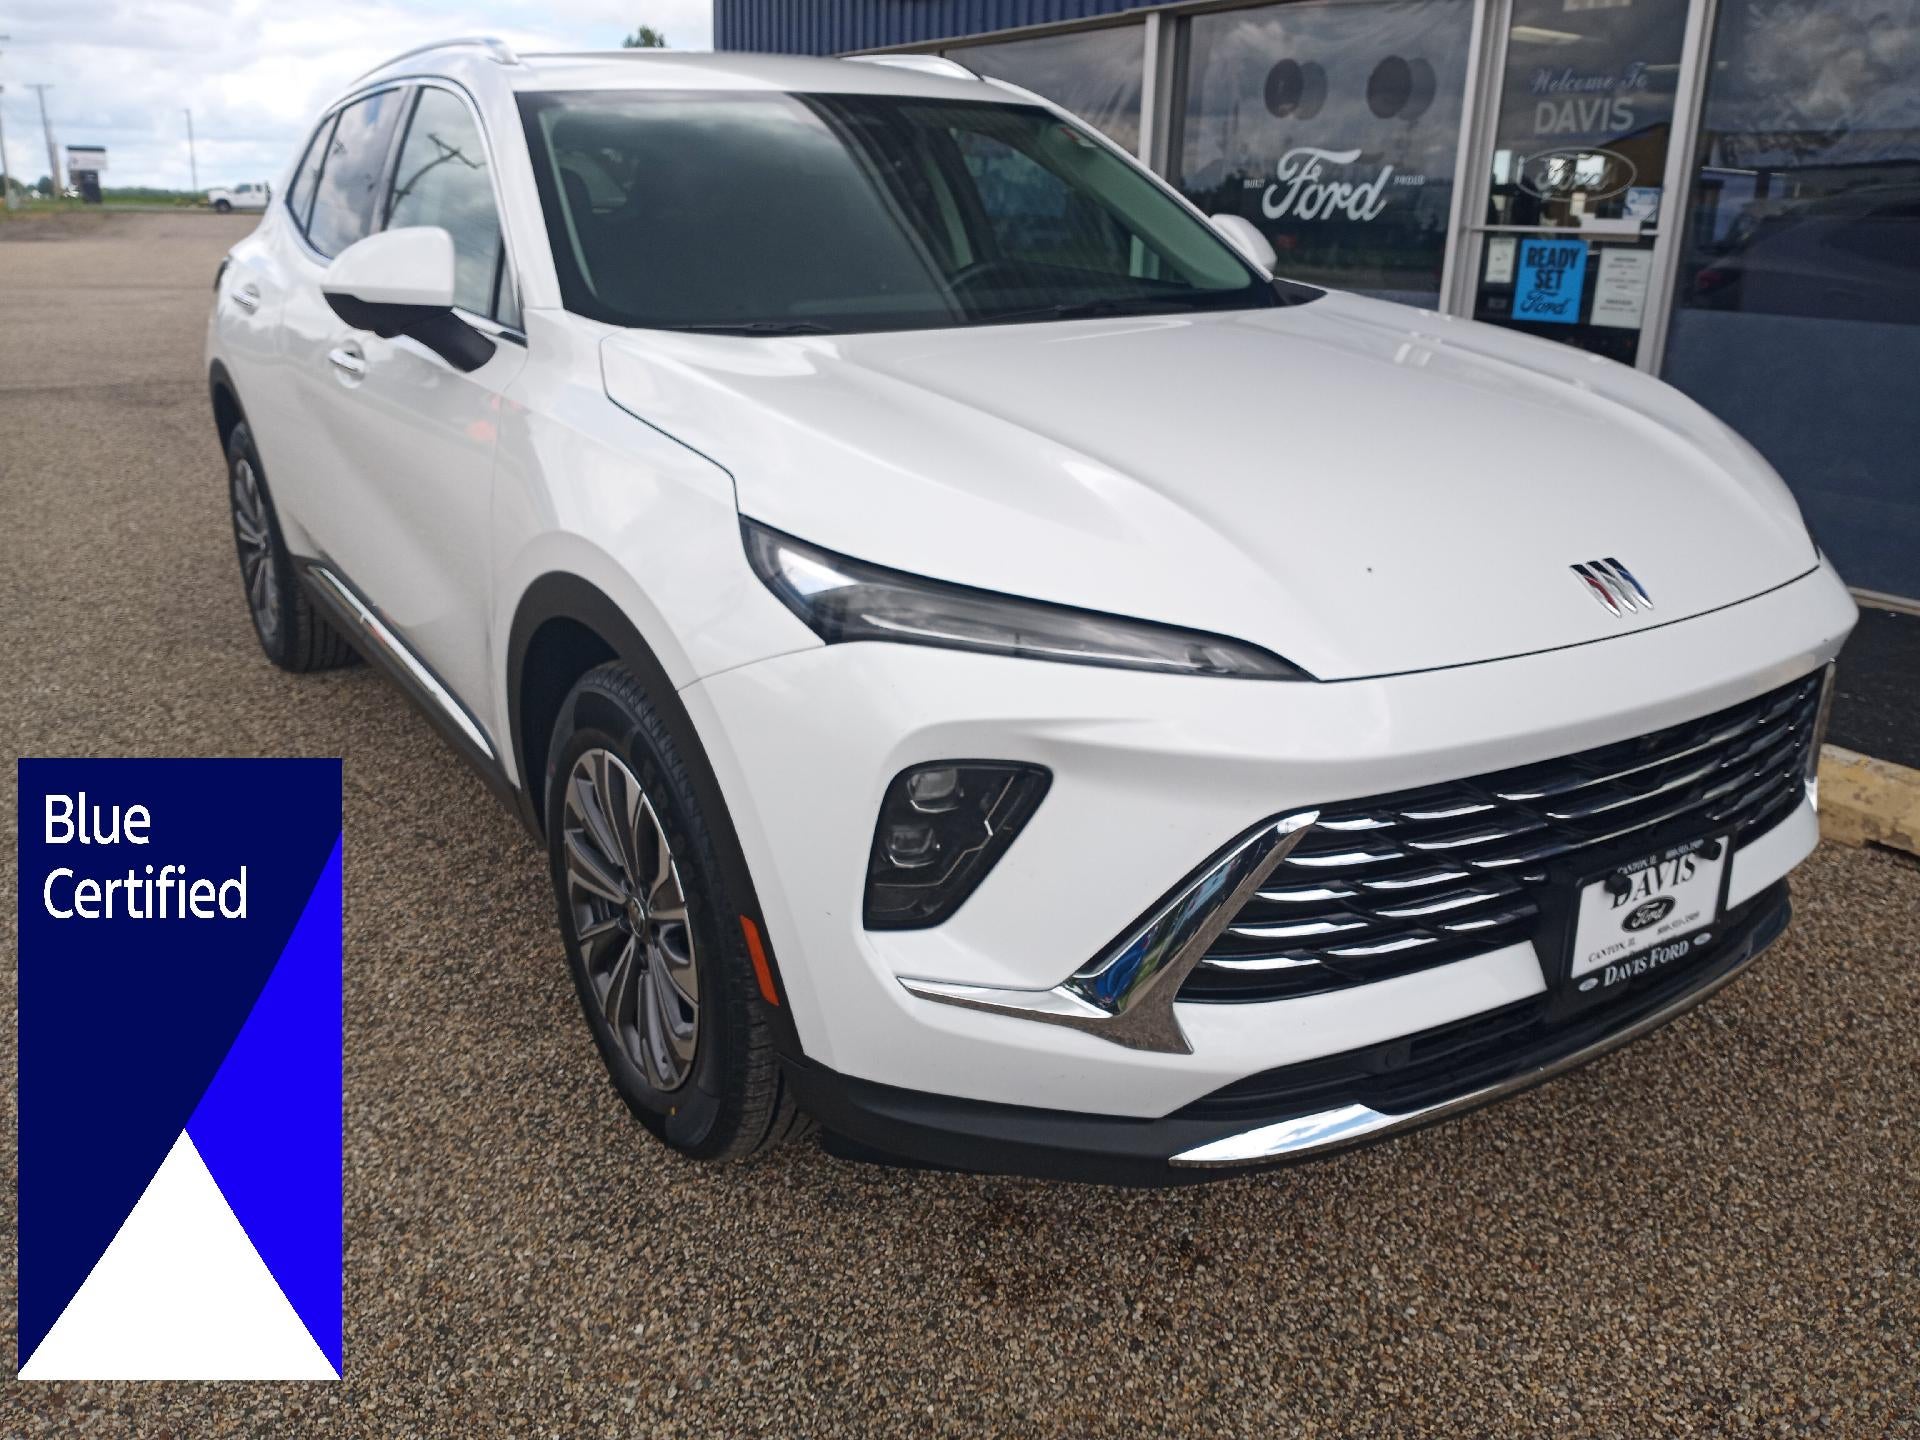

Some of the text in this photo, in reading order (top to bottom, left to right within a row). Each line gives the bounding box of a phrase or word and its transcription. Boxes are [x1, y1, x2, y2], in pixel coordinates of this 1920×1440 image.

[1531, 61, 1649, 96] Welcome To
[1533, 97, 1635, 135] DAVIS
[1262, 147, 1394, 221] Ford
[1526, 247, 1581, 269] READY
[1535, 269, 1565, 290] SET
[1520, 290, 1570, 315] Ford
[1610, 852, 1696, 910] DAVIS
[1631, 901, 1668, 928] Ford
[1603, 956, 1648, 987] DAVIS
[1650, 940, 1690, 968] FORD
